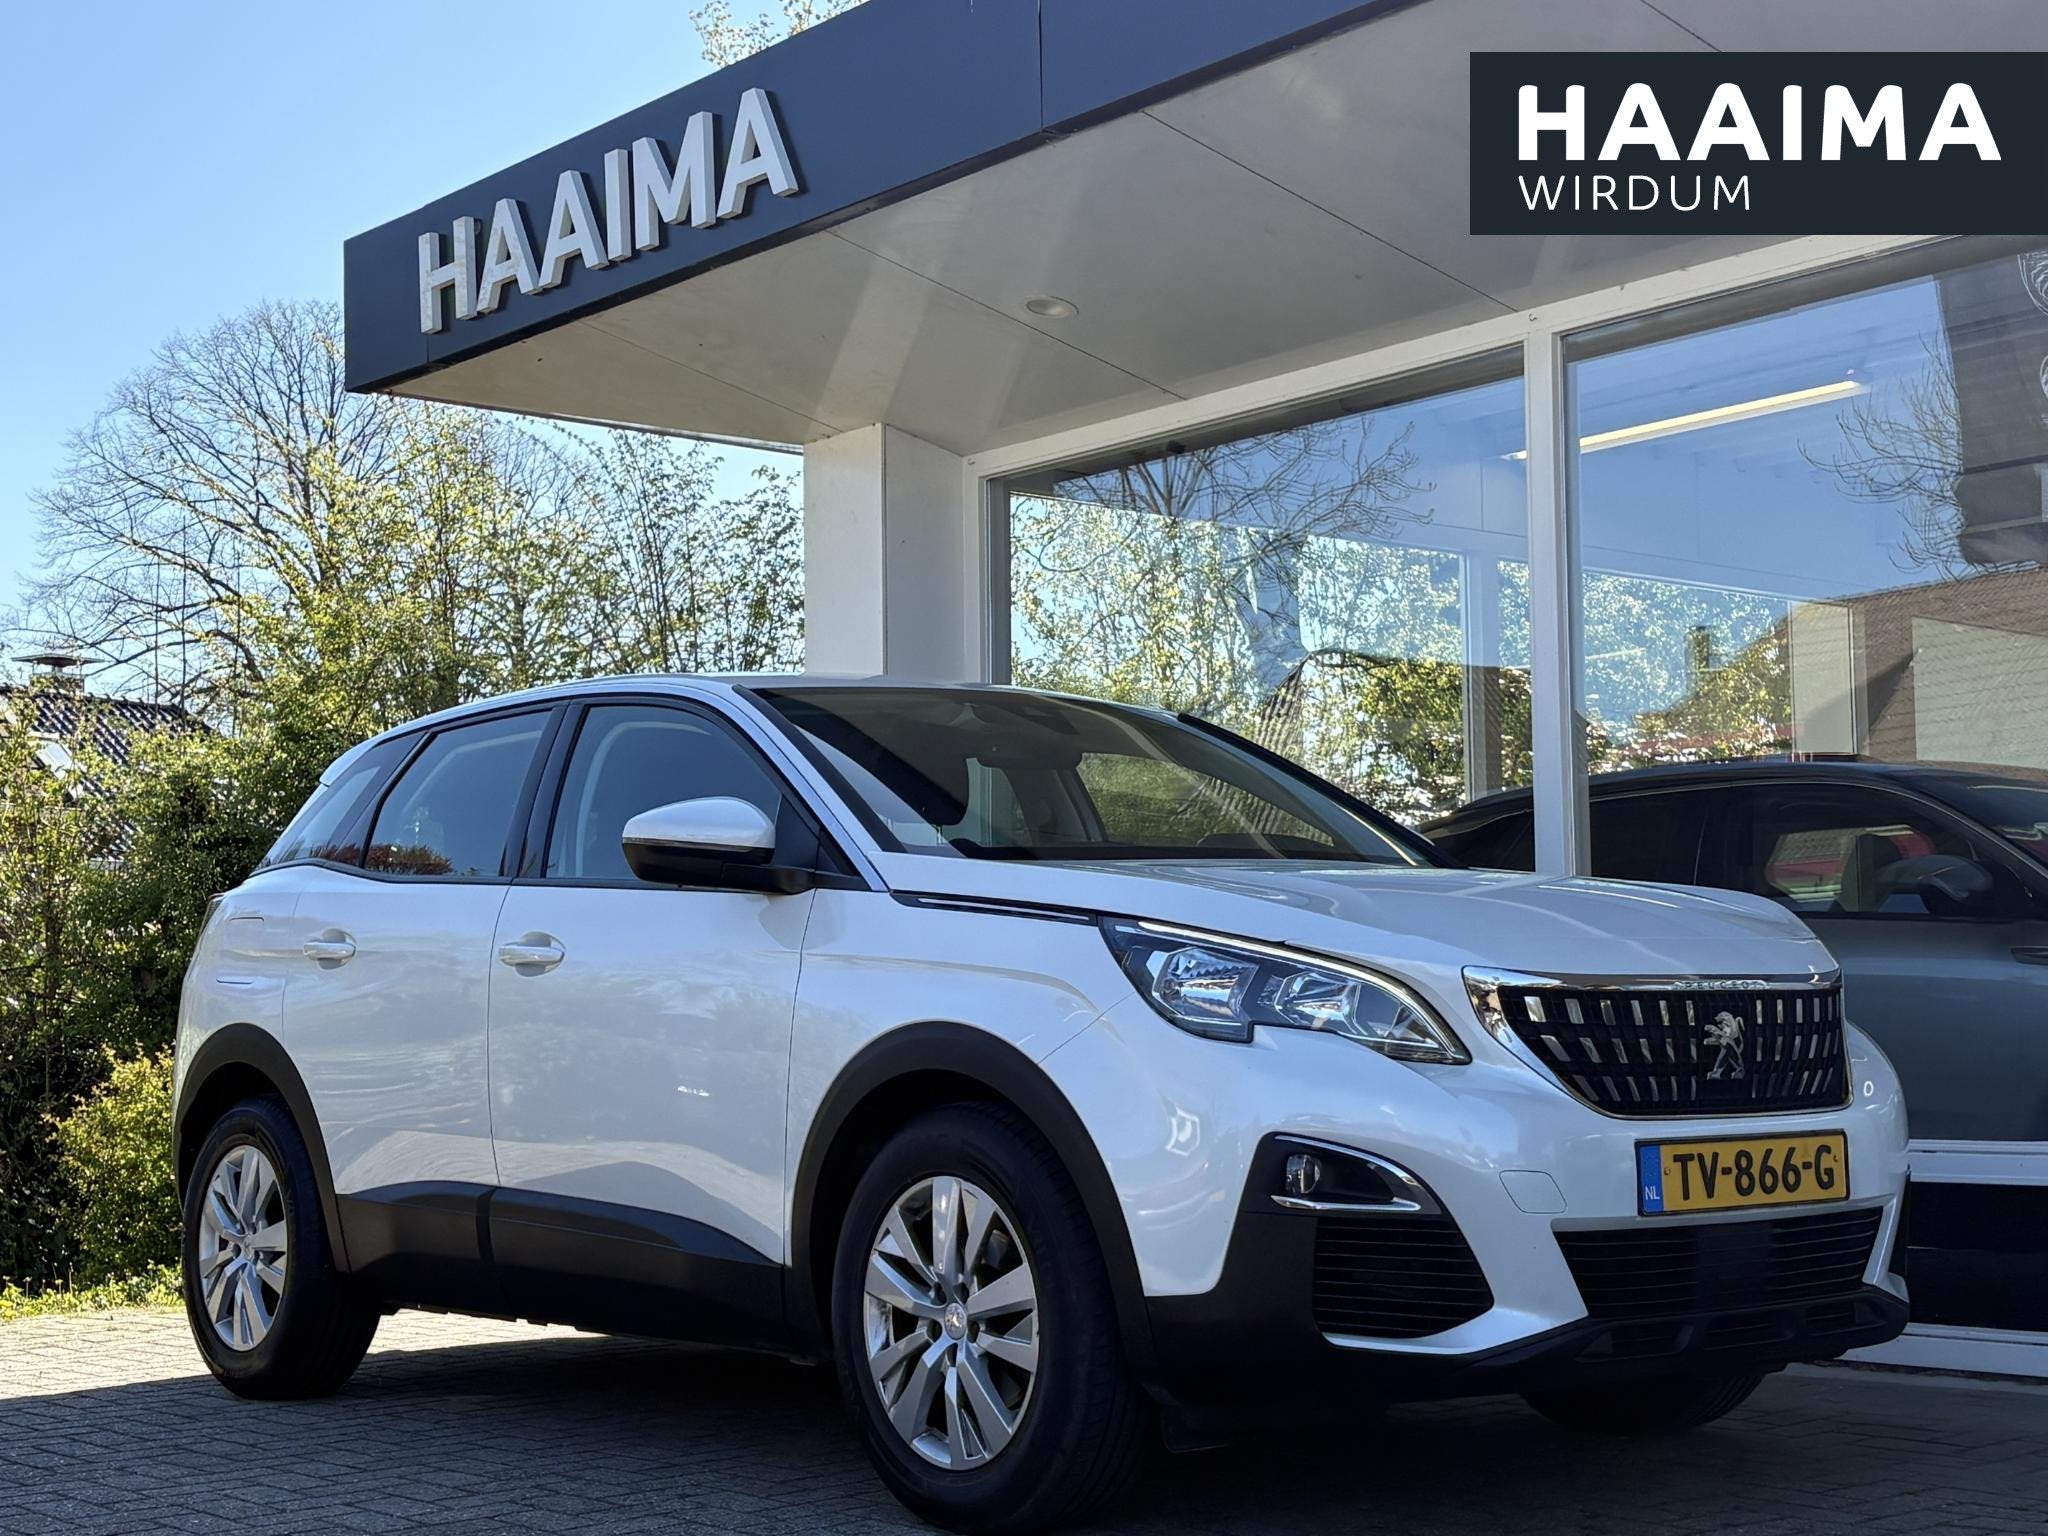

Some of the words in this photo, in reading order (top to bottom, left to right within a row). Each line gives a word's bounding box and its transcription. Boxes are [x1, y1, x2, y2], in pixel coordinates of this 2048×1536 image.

[418, 87, 799, 334] HAAIMA
[1645, 1186, 1660, 1200] NL
[1673, 1145, 1835, 1200] TV-866-G
